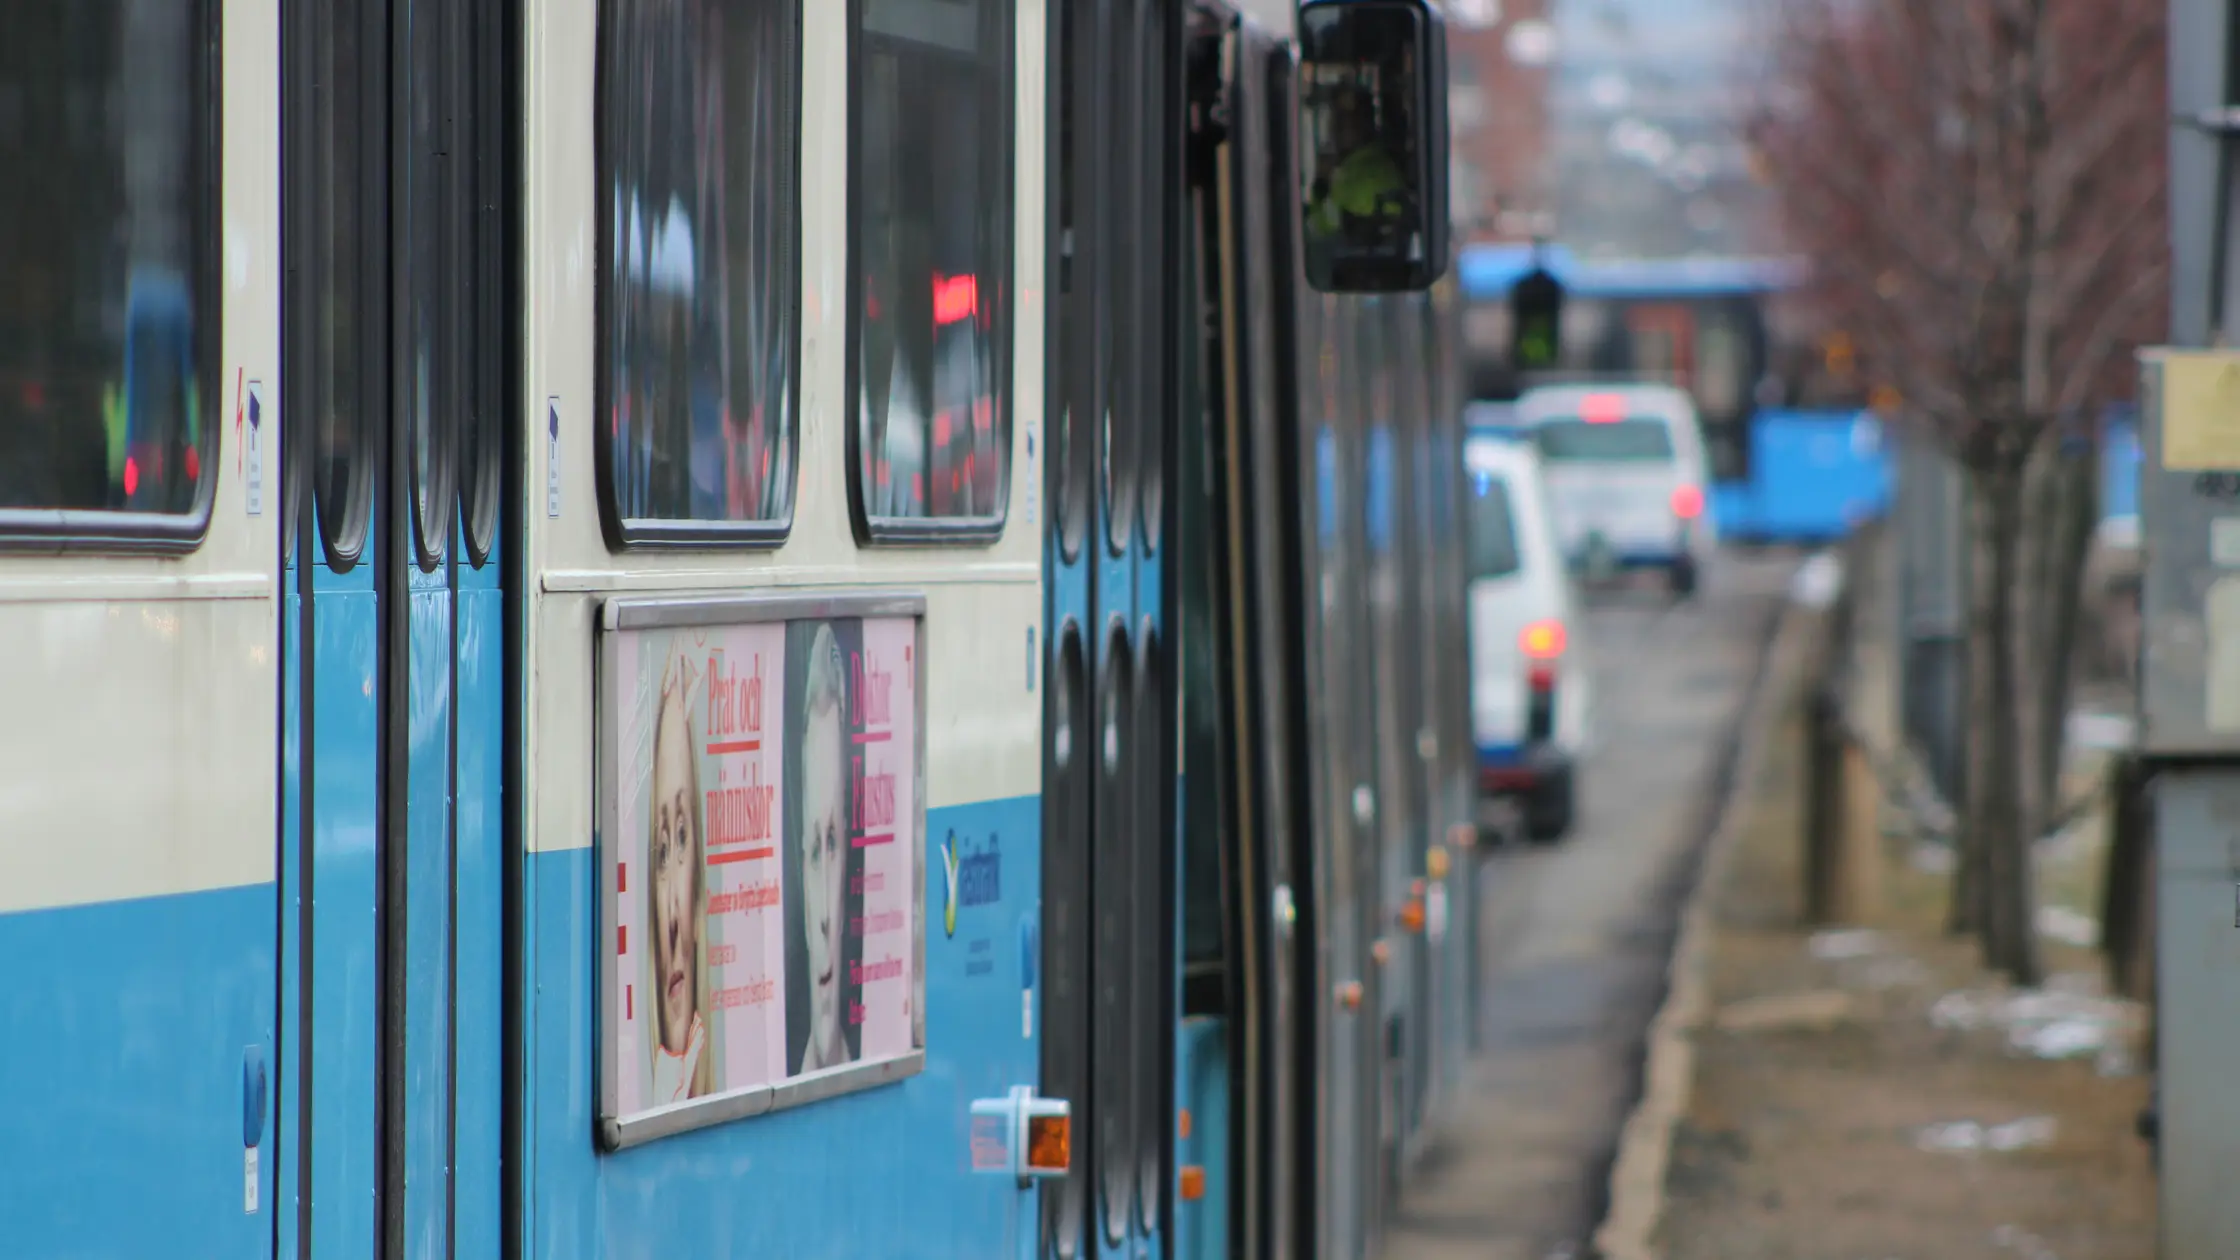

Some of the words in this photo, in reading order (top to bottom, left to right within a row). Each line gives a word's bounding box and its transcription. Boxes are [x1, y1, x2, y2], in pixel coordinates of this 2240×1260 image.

[707, 657, 736, 736] Prat
[740, 652, 762, 733] och
[706, 762, 774, 846] människor
